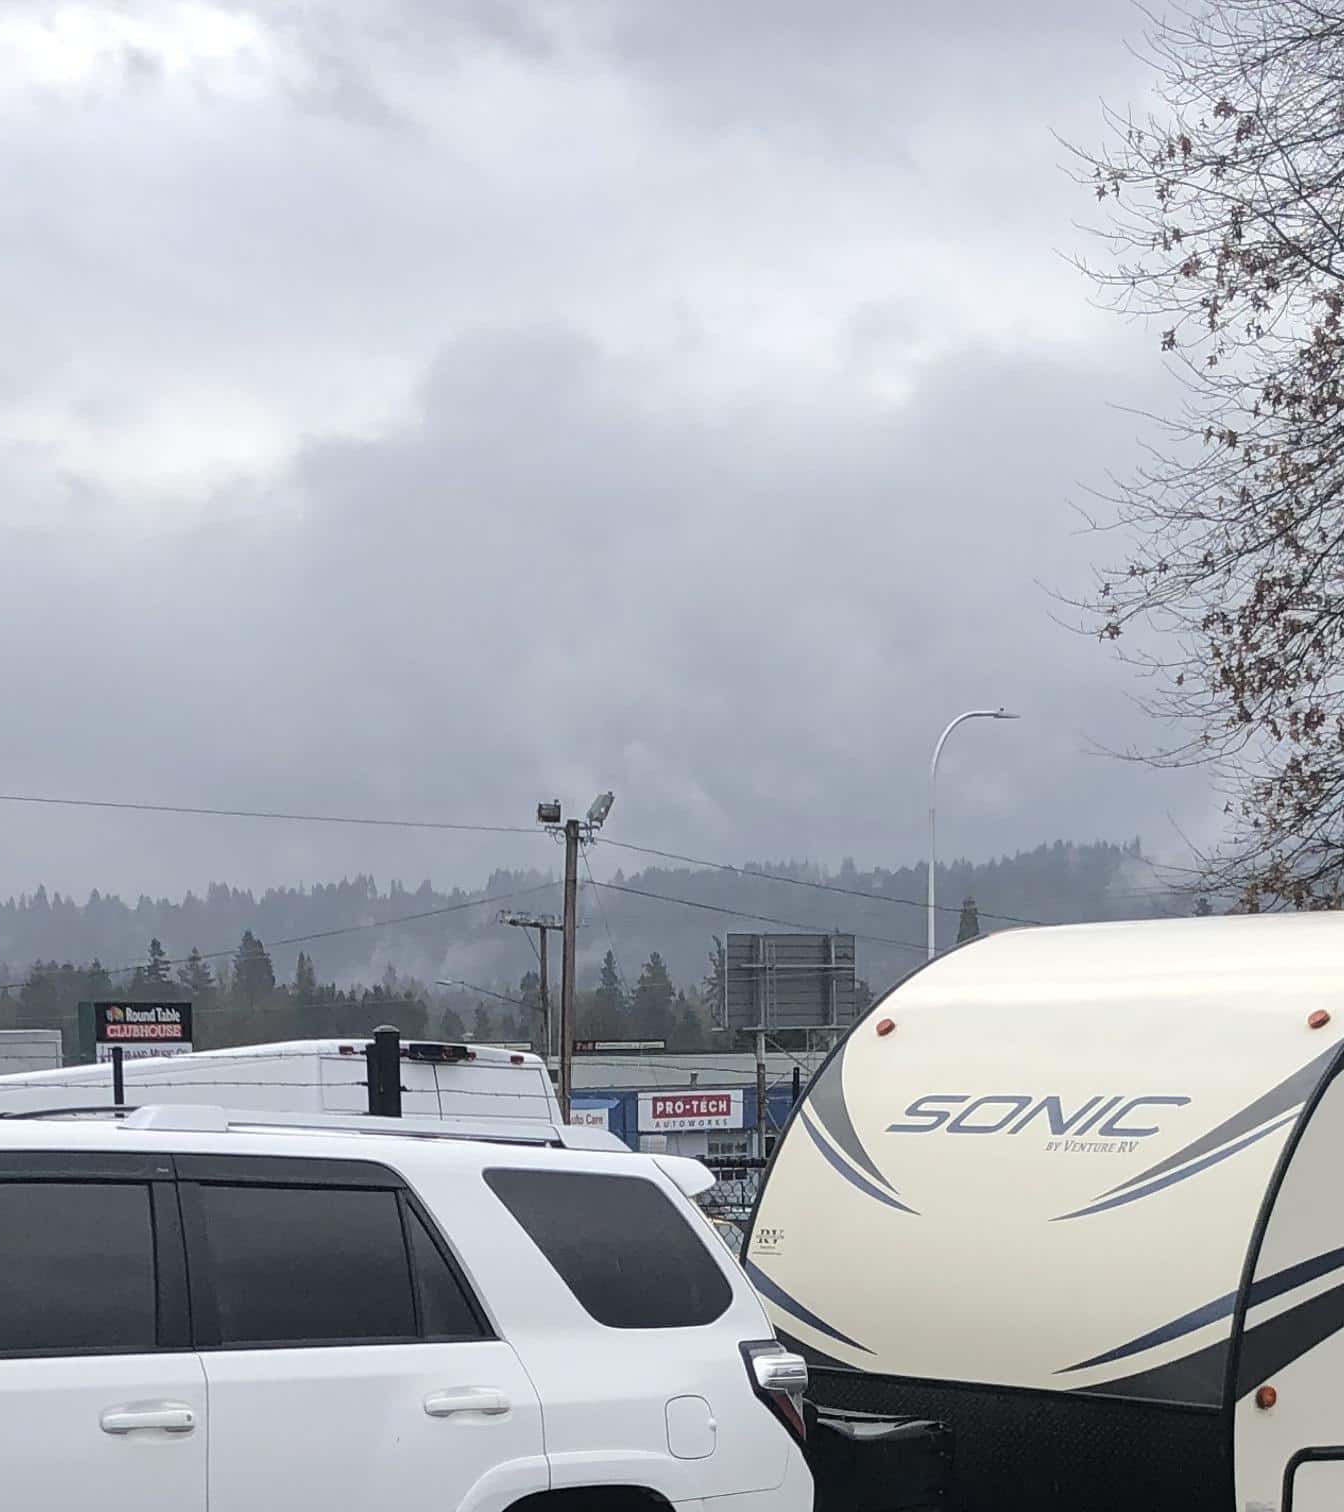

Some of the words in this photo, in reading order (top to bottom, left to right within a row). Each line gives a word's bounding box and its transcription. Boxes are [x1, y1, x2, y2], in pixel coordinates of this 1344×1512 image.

[126, 1007, 155, 1022] Round
[156, 1007, 181, 1022] Table
[106, 1024, 182, 1037] CLUBHOUSE
[656, 1100, 727, 1115] PRO-TECH
[586, 1113, 604, 1125] Care
[885, 1095, 1192, 1137] SONIC
[655, 1119, 728, 1128] AUTOWORKS
[1118, 1140, 1139, 1152] RV
